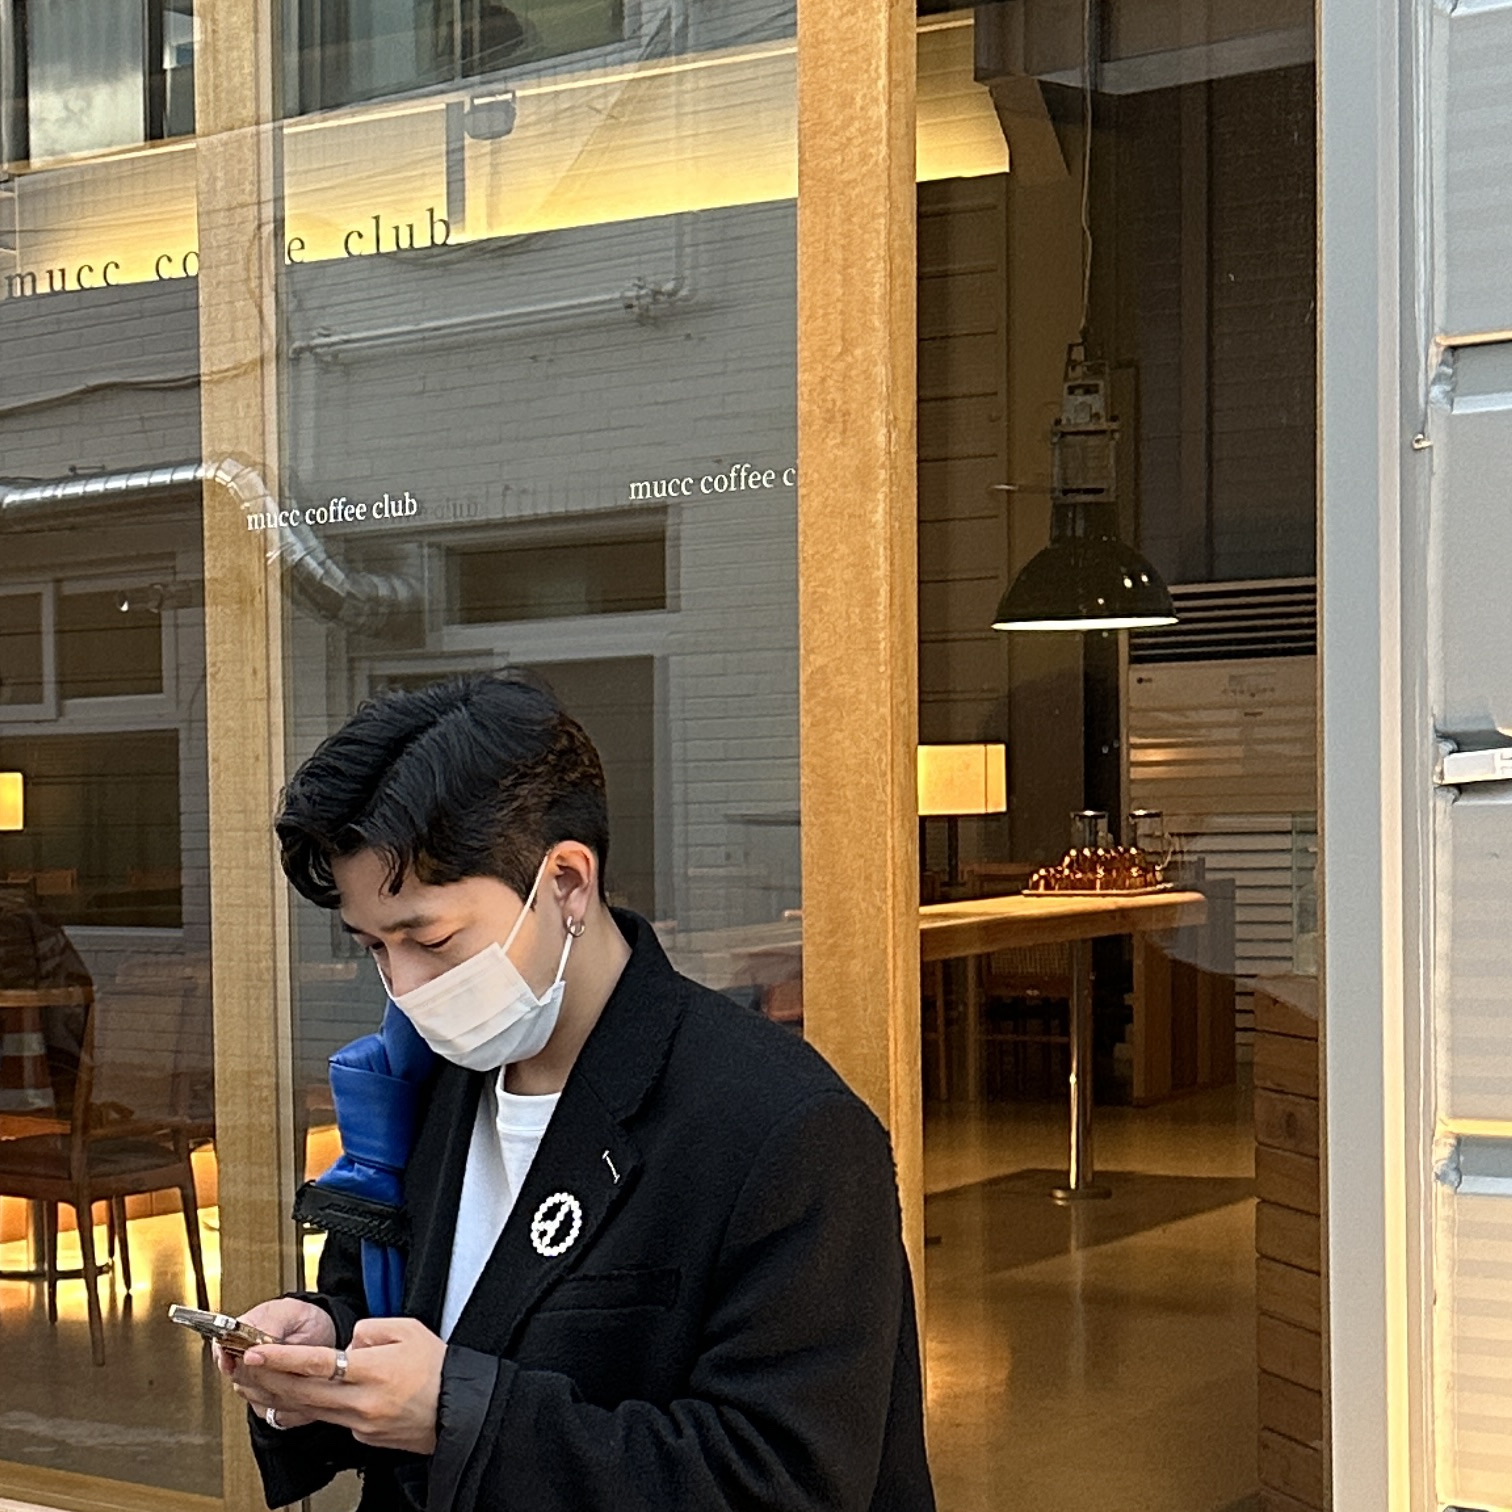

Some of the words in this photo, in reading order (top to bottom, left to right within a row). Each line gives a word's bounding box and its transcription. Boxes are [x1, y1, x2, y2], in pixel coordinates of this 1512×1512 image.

[5, 260, 121, 300] mucc
[155, 236, 305, 282] coe
[344, 207, 450, 257] club
[629, 477, 694, 500] mucc
[700, 463, 776, 494] coffee
[247, 509, 300, 531] mucc
[305, 497, 367, 526] coffee
[372, 492, 417, 519] club
